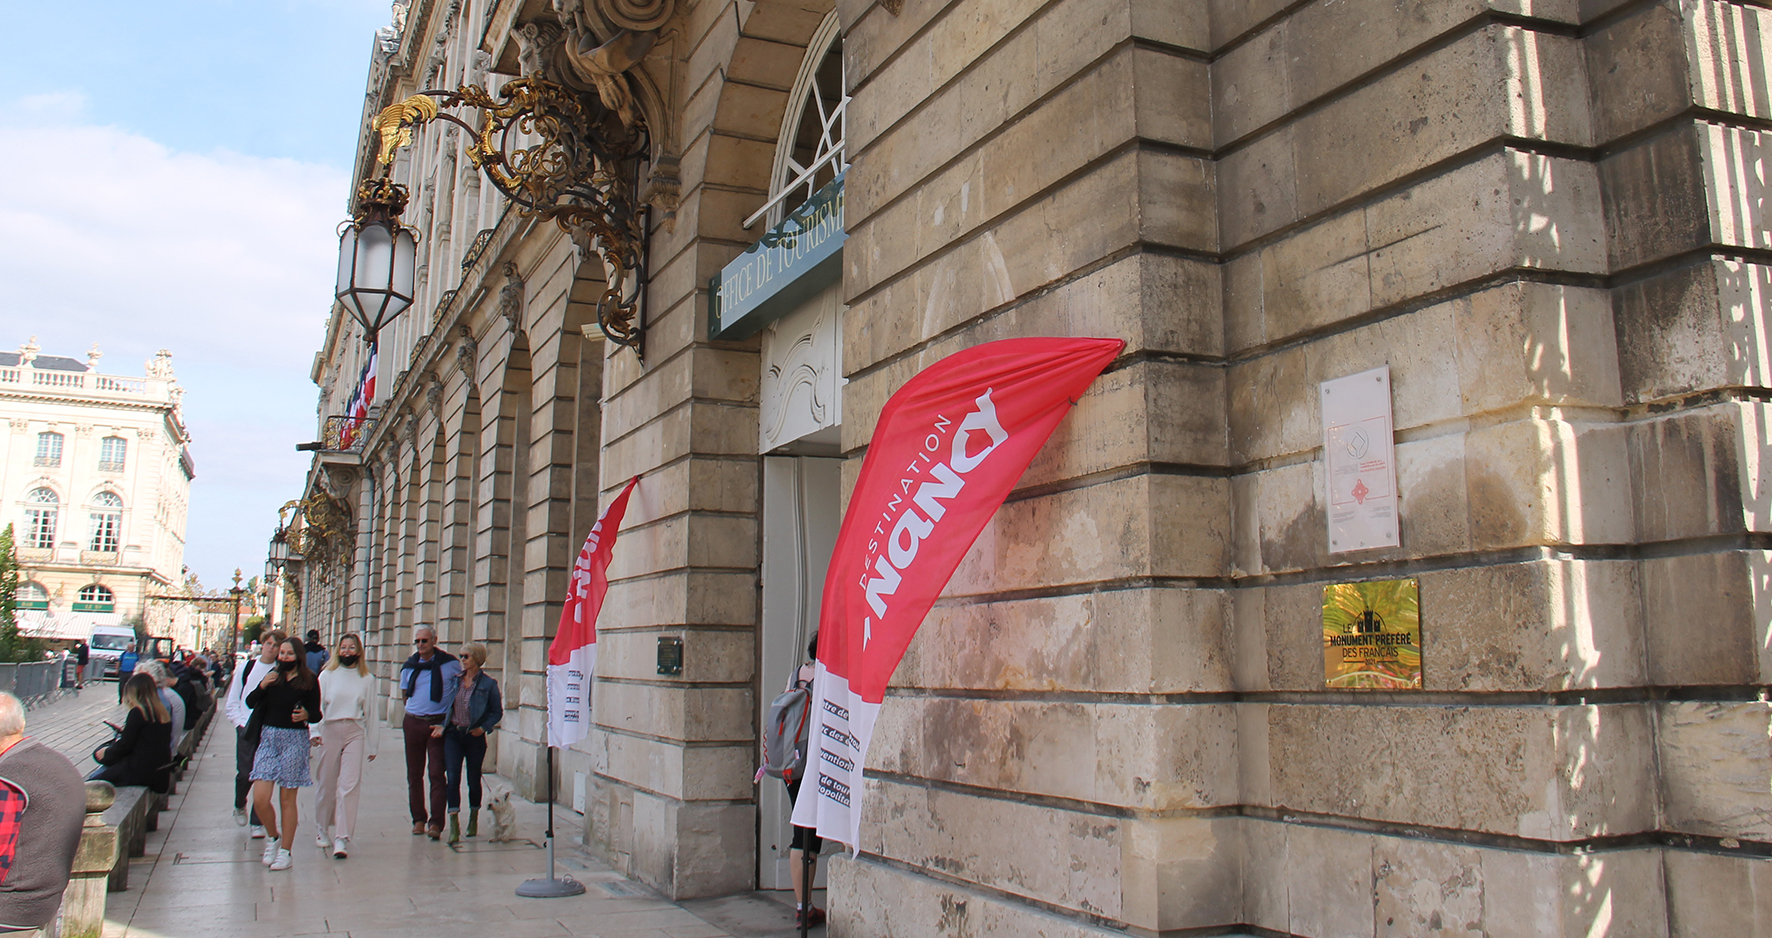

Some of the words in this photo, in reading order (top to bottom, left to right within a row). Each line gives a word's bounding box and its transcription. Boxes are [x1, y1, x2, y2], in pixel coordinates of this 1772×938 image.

[715, 262, 752, 319] OFFICE
[756, 246, 773, 290] DE
[777, 190, 845, 274] TOURISM
[858, 413, 952, 591] DESTINATION
[1343, 624, 1353, 633] LE
[1330, 635, 1374, 646] MONUMENT
[1376, 631, 1412, 645] PRÉFÉRÉ
[1342, 647, 1358, 658] DES
[1359, 647, 1399, 660] FRANÇAIS
[824, 701, 837, 713] tre
[829, 730, 845, 742] des
[821, 776, 832, 786] de
